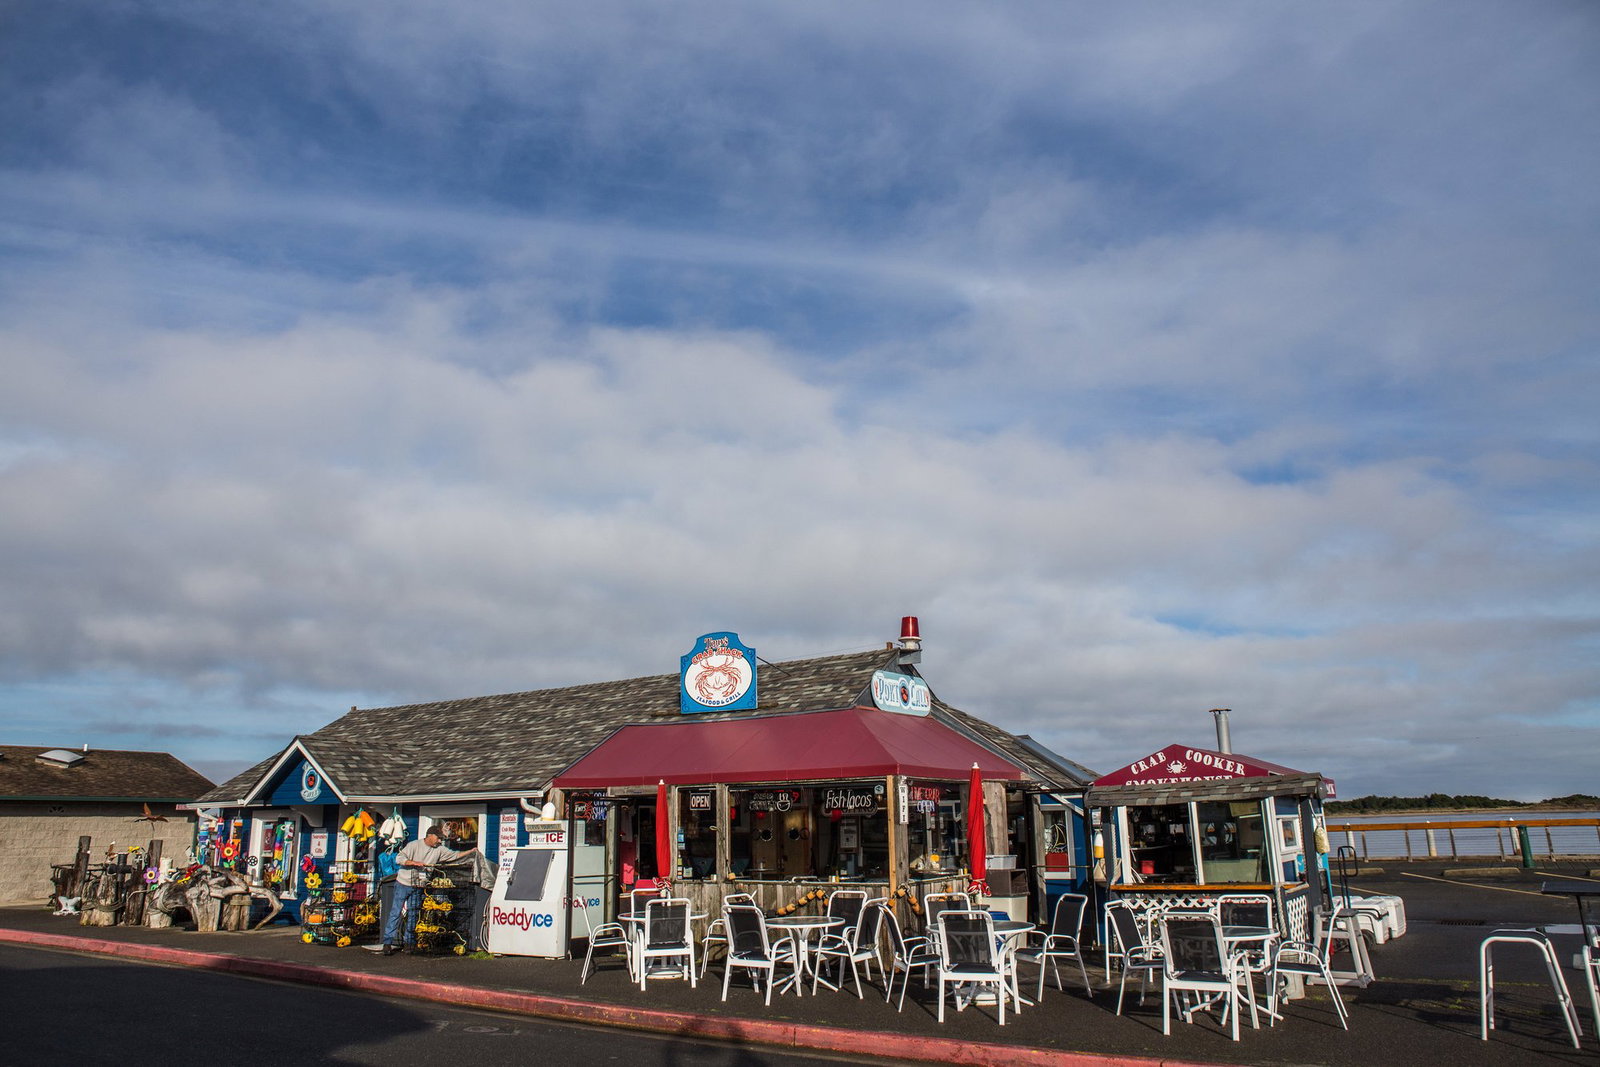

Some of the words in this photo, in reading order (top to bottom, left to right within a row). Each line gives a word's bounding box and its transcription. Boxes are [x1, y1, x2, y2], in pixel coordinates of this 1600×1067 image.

[693, 649, 713, 664] CRAB
[716, 648, 743, 658] SHACK
[726, 692, 741, 702] GRILL
[1130, 751, 1167, 775] CRAB
[1185, 749, 1246, 776] COOKER
[691, 795, 710, 808] OPEN
[917, 800, 936, 814] OPEN
[545, 832, 564, 843] ICE
